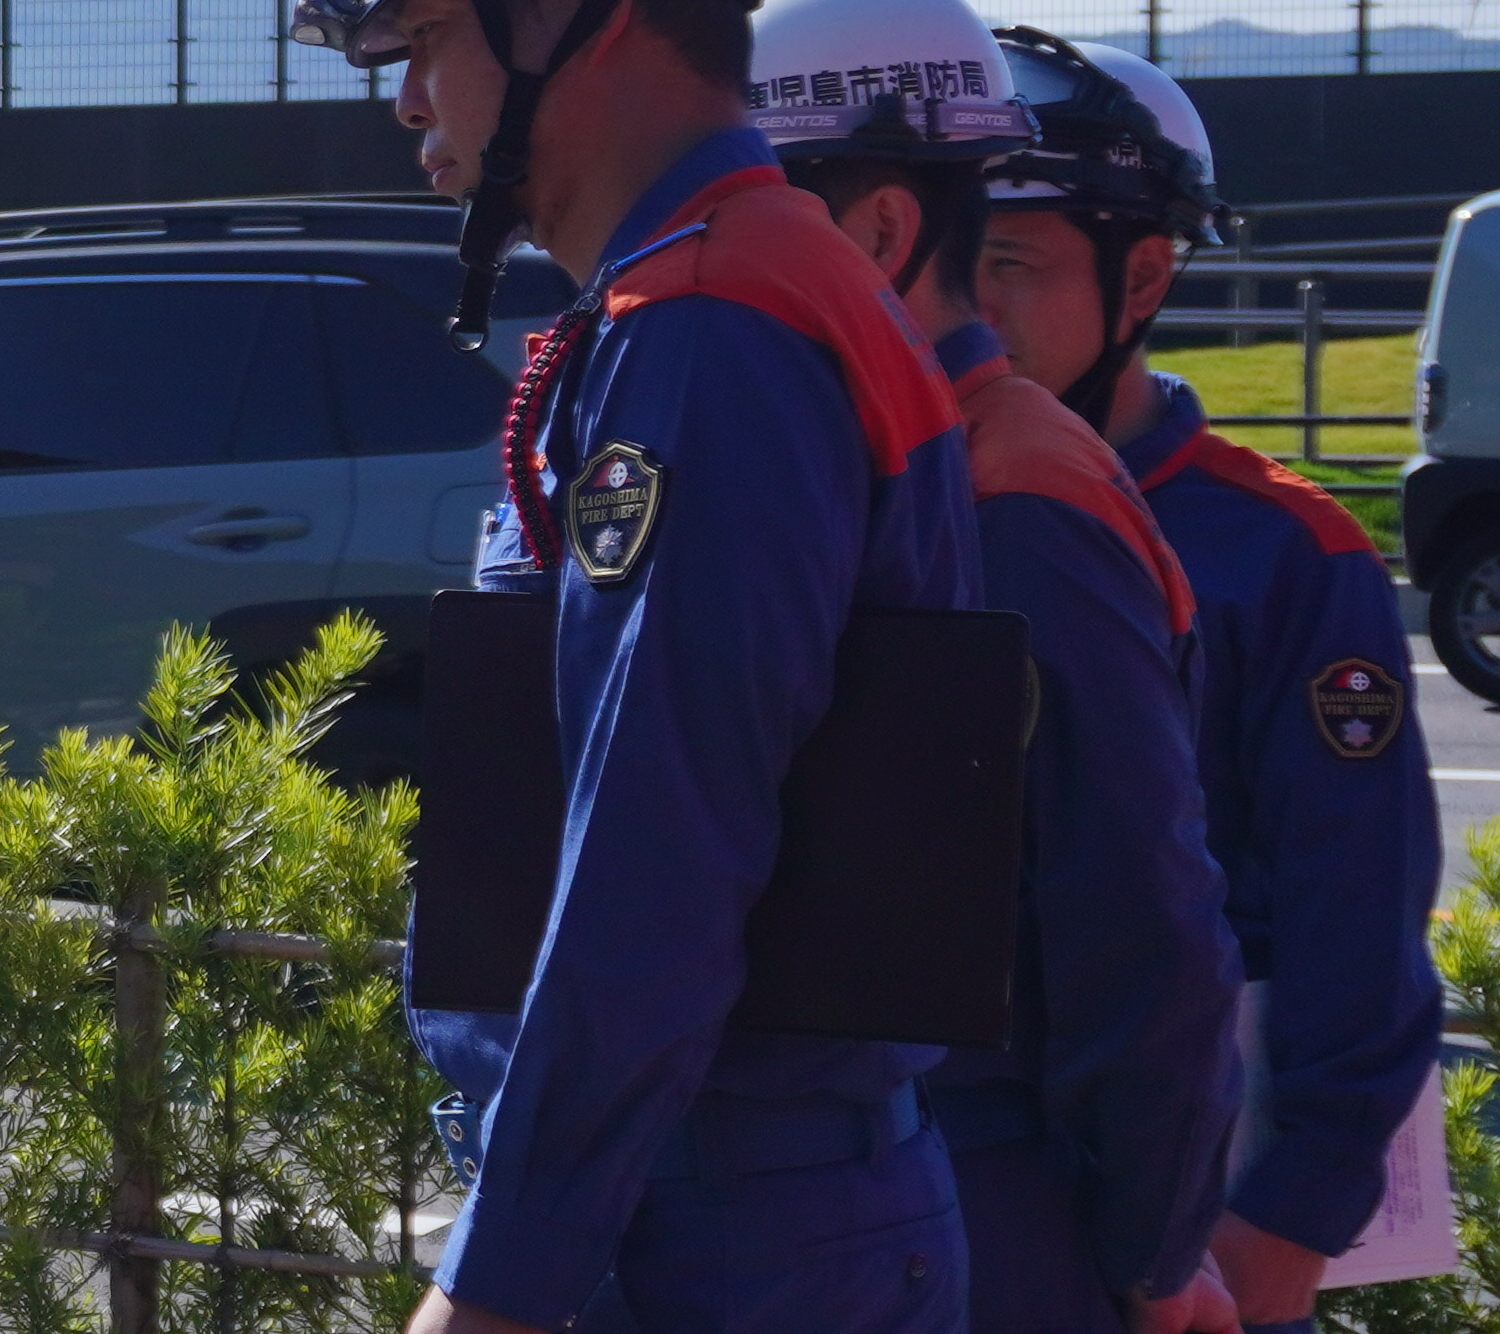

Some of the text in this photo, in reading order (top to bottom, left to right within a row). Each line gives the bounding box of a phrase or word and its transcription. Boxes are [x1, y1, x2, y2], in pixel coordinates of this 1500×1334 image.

[754, 114, 839, 129] GENTOS
[954, 111, 1013, 127] GENTOS
[577, 487, 649, 510] KAGOSHIMA
[581, 503, 646, 525] FIRE DEPT
[1319, 691, 1395, 704] KAGOSHIMA
[1324, 703, 1393, 716] FIRE DEPT
